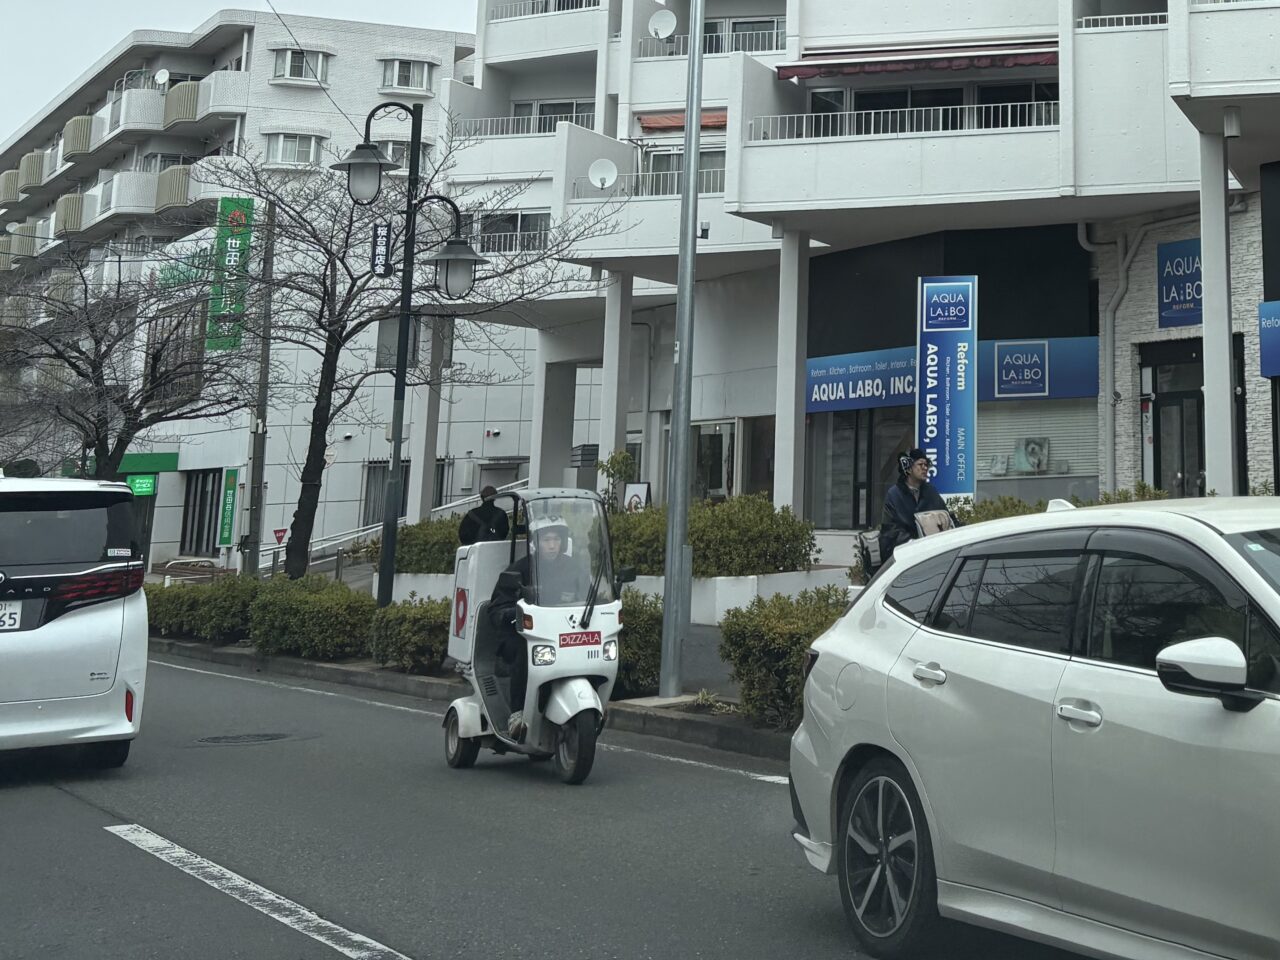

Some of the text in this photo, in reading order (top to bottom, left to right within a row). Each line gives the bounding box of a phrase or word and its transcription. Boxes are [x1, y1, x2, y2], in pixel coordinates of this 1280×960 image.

[374, 226, 388, 274] 桜台商店会
[1163, 256, 1202, 277] AQUA
[931, 293, 965, 303] AQUA
[1163, 281, 1203, 302] LABO
[930, 306, 966, 317] LABO
[926, 343, 938, 389] AQUA
[956, 342, 968, 390] Reform
[1003, 353, 1041, 365] AQUA
[1002, 368, 1042, 380] LABO
[811, 381, 846, 402] AQUA
[848, 378, 886, 400] LABO,
[923, 393, 938, 443] LABO,
[957, 427, 966, 481] MAIN OFFICE
[559, 633, 601, 647] PIZZA-LA
